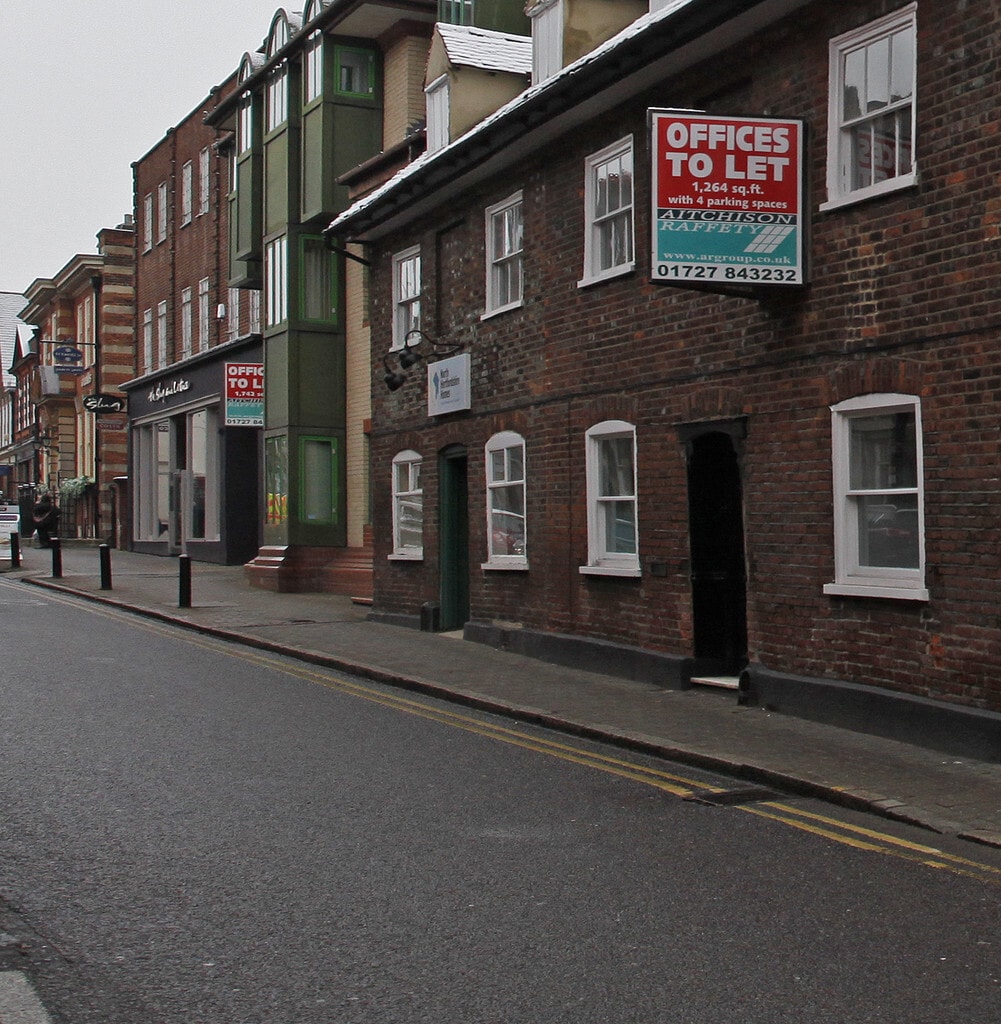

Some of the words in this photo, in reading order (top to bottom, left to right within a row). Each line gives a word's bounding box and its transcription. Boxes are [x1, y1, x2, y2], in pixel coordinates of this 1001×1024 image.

[666, 122, 790, 154] OFFICES
[665, 152, 713, 178] TO
[725, 154, 790, 182] LET
[691, 181, 728, 193] 1,264
[731, 183, 764, 197] sq.ft.
[668, 195, 693, 205] with
[696, 196, 704, 205] 4
[707, 197, 749, 210] parking
[751, 200, 788, 210] spaces
[659, 209, 795, 224] AITCHISON
[659, 221, 763, 234] RAFFETY
[663, 252, 791, 265] www.argroup.co.uk
[657, 264, 718, 278] 01727
[725, 267, 797, 282] 843232
[228, 366, 265, 376] OFFIC
[228, 378, 248, 389] TO
